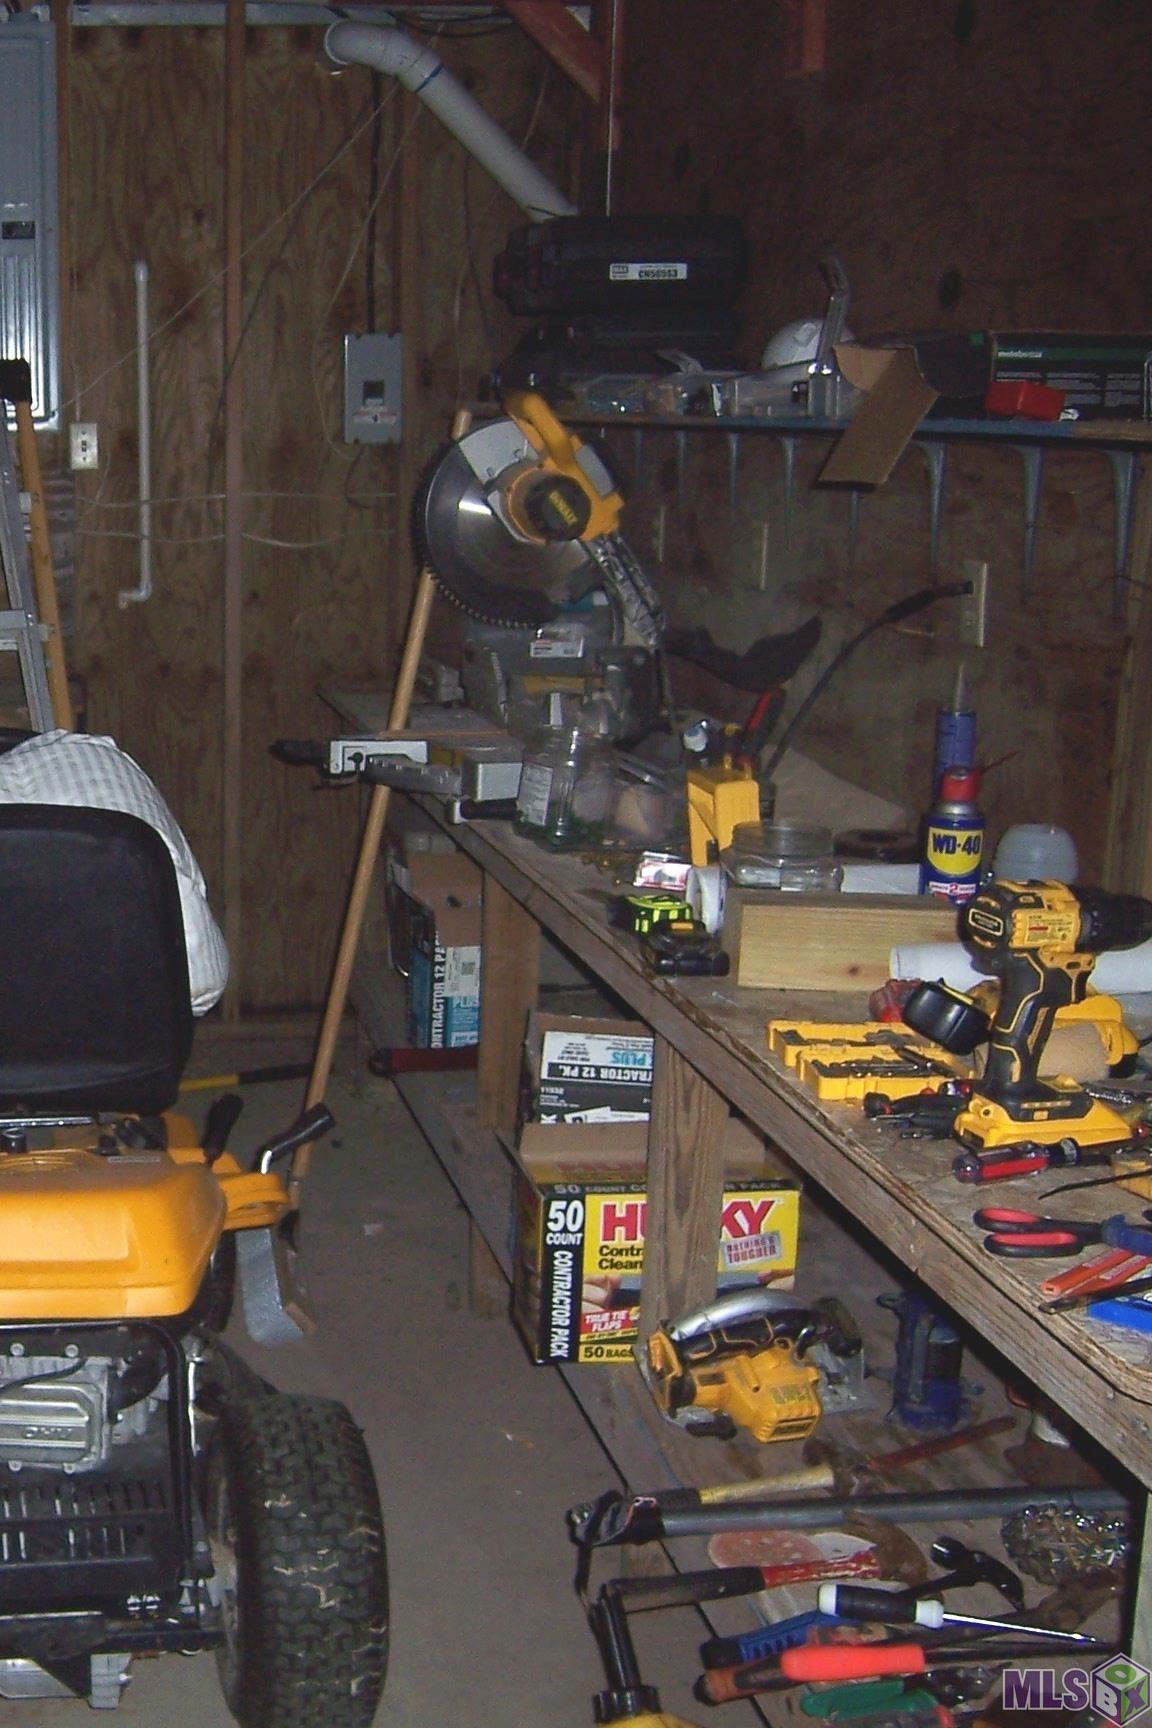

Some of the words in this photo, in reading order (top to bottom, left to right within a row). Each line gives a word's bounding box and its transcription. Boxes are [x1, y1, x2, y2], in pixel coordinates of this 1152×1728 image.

[932, 832, 982, 855] WD-40
[431, 983, 445, 1048] ONTRACTOR
[611, 1051, 646, 1066] PLUS
[582, 1066, 596, 1078] 12
[600, 1067, 652, 1082] TRACTOR
[547, 1200, 584, 1232] 50
[545, 1232, 584, 1246] COUNT
[598, 1243, 645, 1257] Contr
[598, 1257, 644, 1270] Clean
[550, 1250, 574, 1327] CONTRACTOR
[592, 1320, 622, 1332] FLAPS
[549, 1328, 569, 1358] PACK
[583, 1346, 604, 1358] 50
